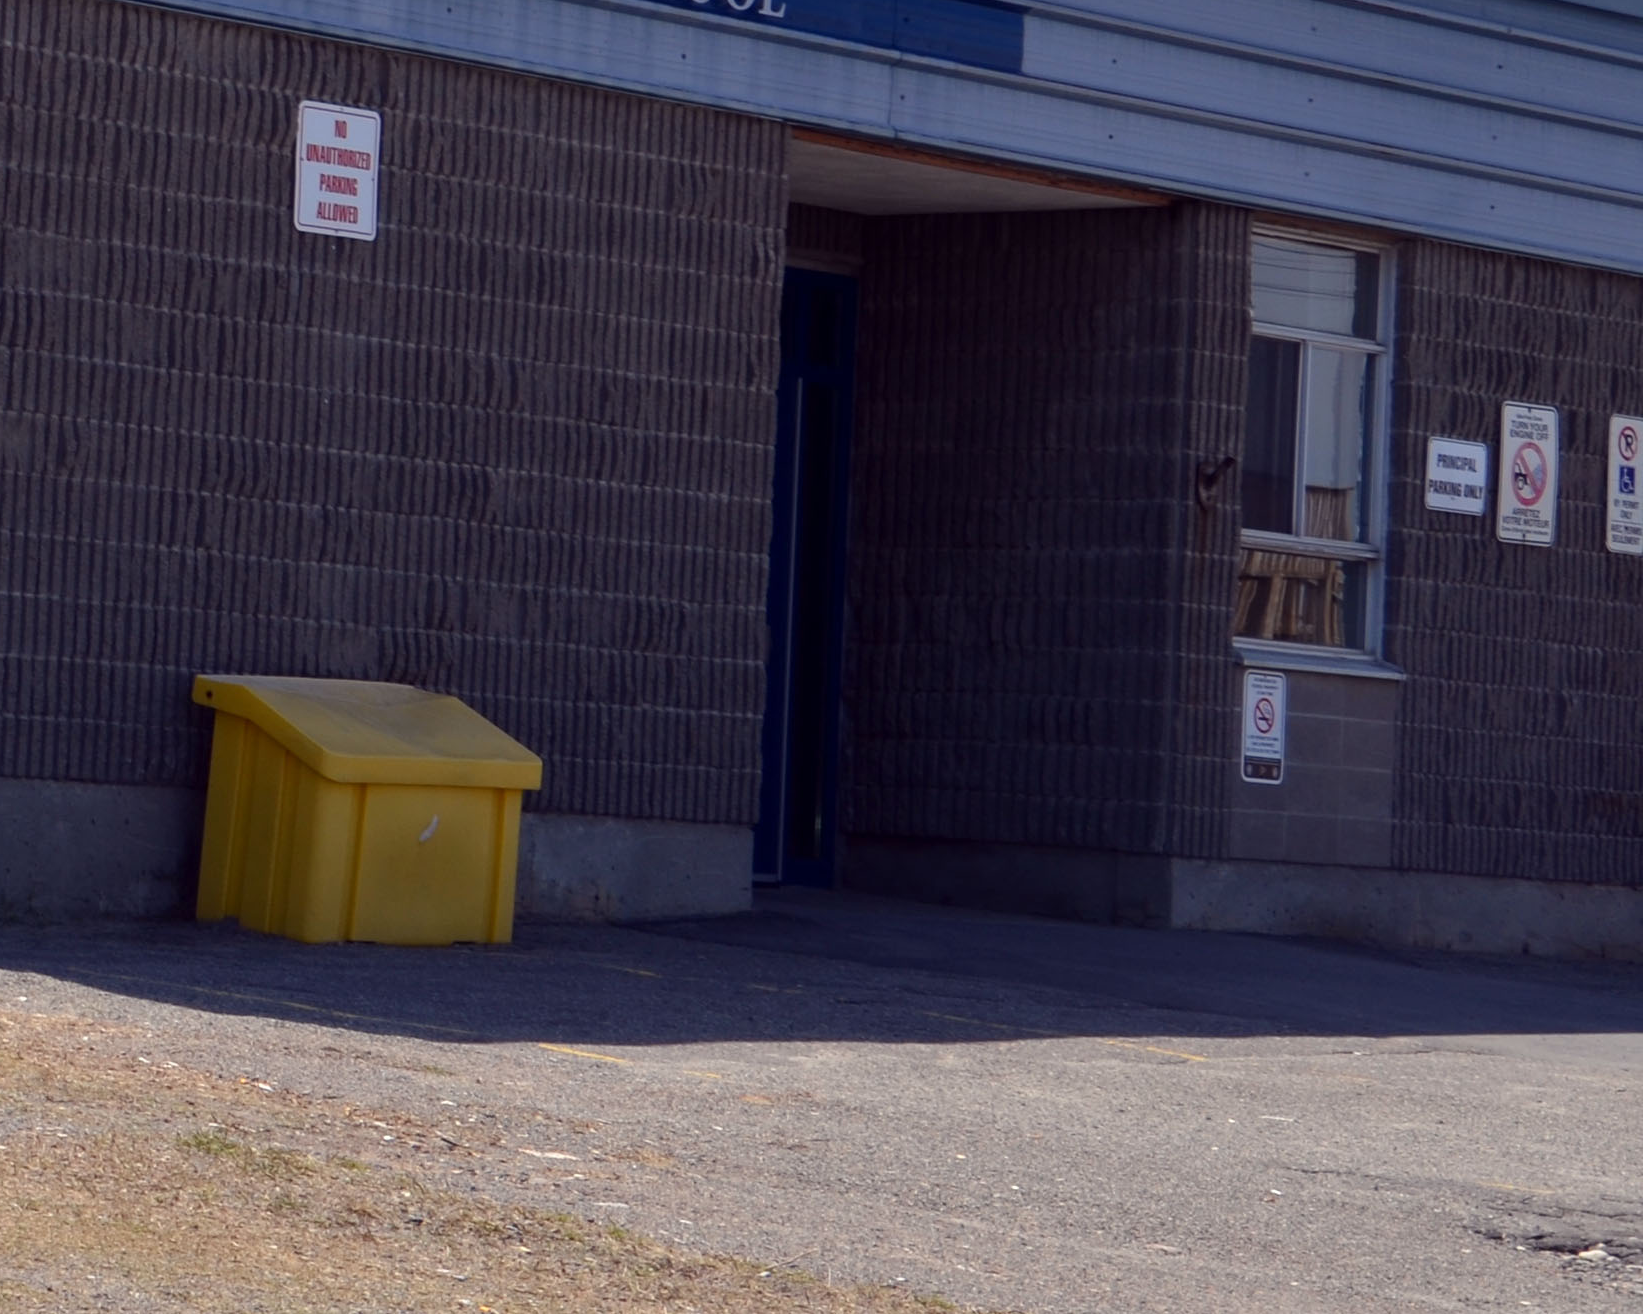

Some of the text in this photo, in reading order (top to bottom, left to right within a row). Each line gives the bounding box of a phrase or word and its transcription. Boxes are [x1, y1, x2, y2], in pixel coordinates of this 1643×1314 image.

[334, 119, 348, 139] NO
[306, 143, 372, 171] UNAUTHORIZED
[319, 173, 358, 197] PARKING
[316, 201, 359, 224] ALLOWED
[1436, 453, 1478, 473] PRINCIPAL
[1428, 479, 1483, 500] PARKING ONLY
